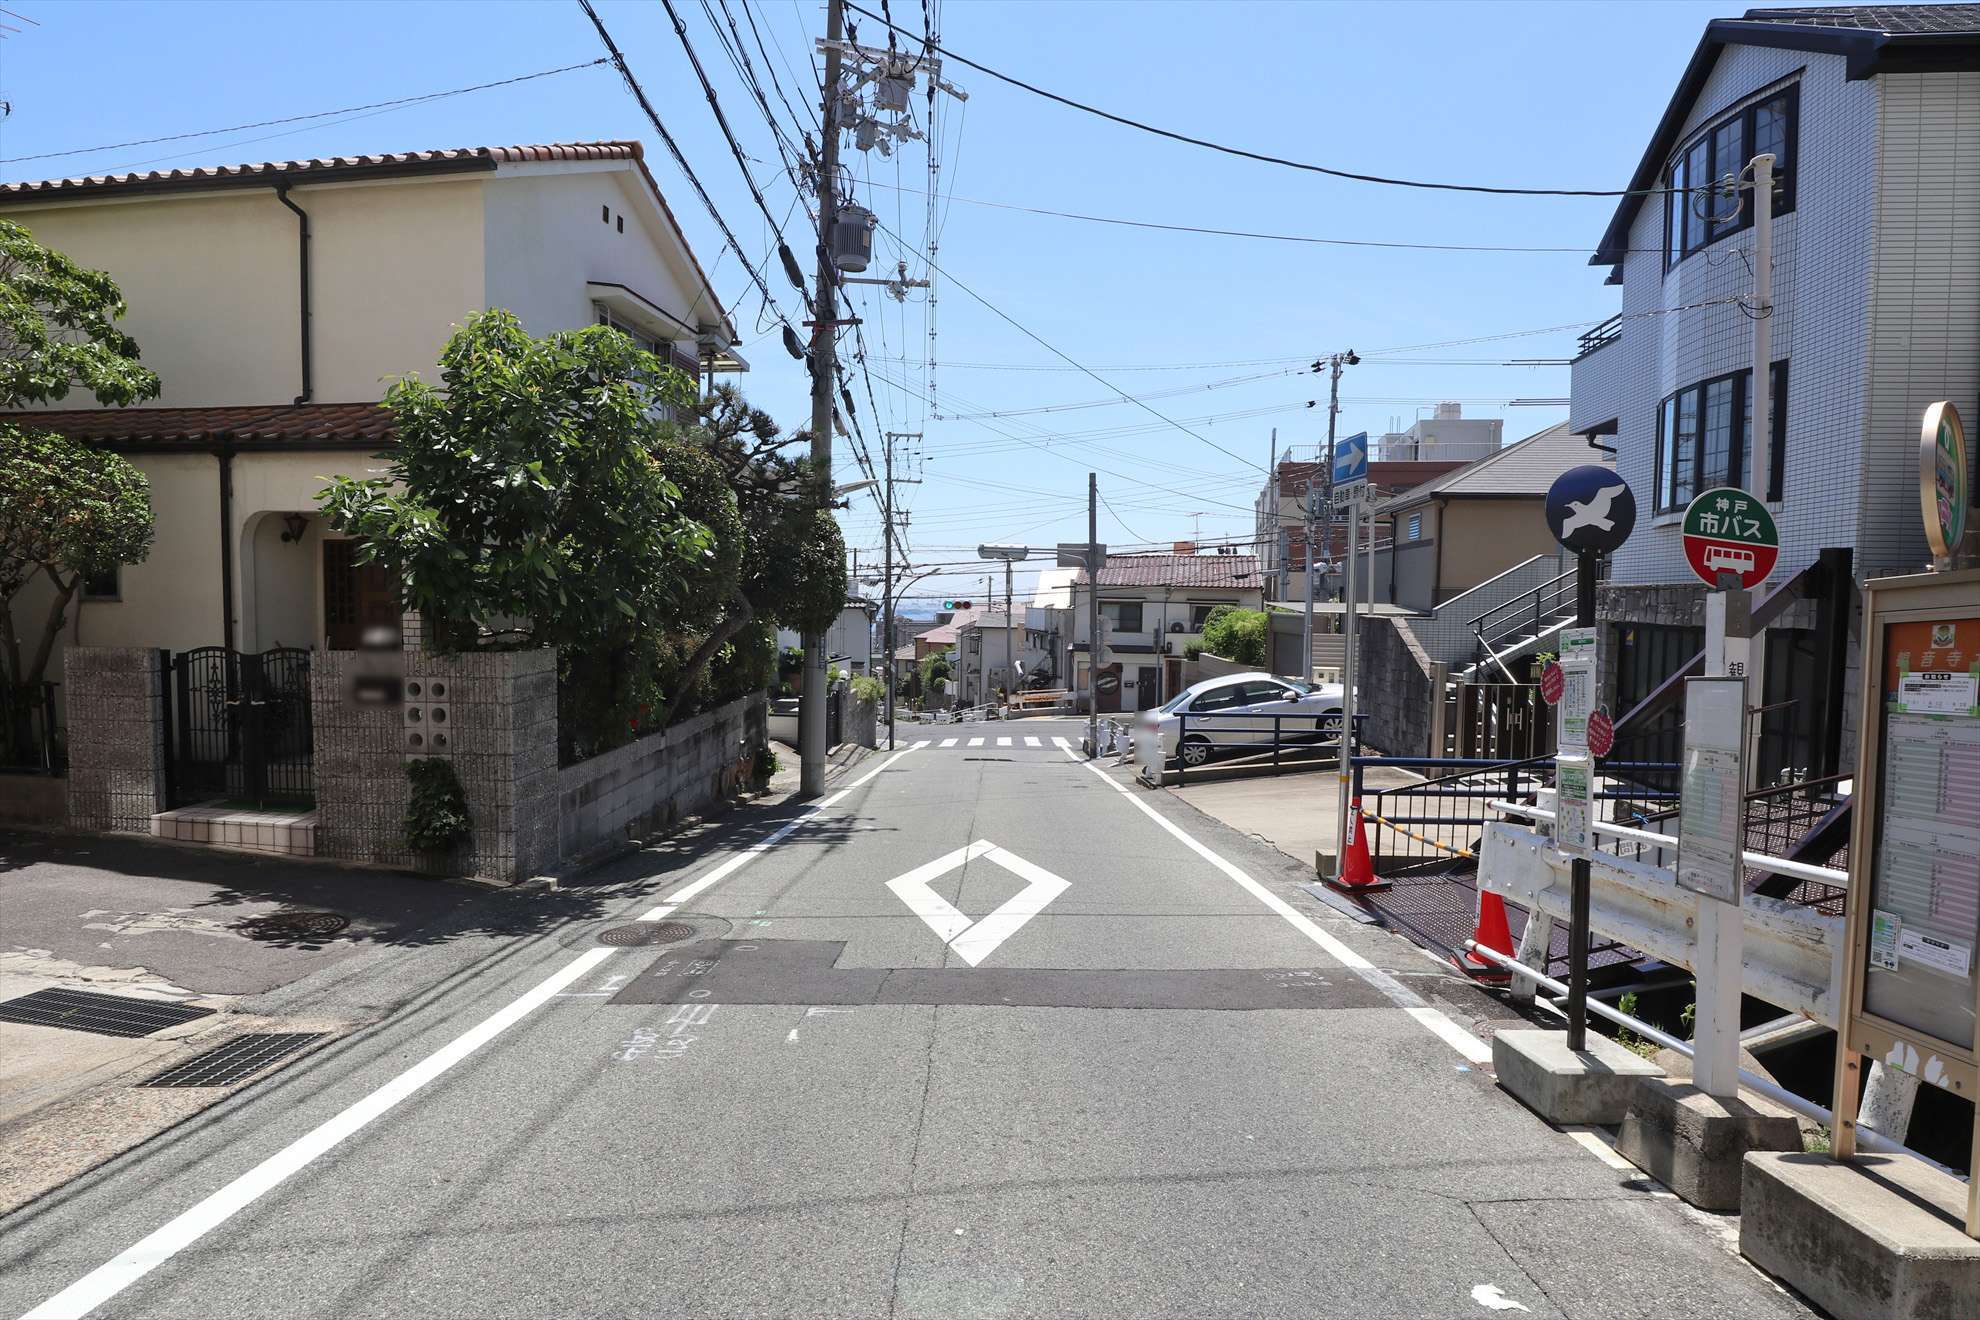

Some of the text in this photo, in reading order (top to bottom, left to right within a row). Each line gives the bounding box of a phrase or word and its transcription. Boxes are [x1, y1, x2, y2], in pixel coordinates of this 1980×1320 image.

[1715, 497, 1748, 513] 神戸
[1699, 512, 1762, 539] 市バス
